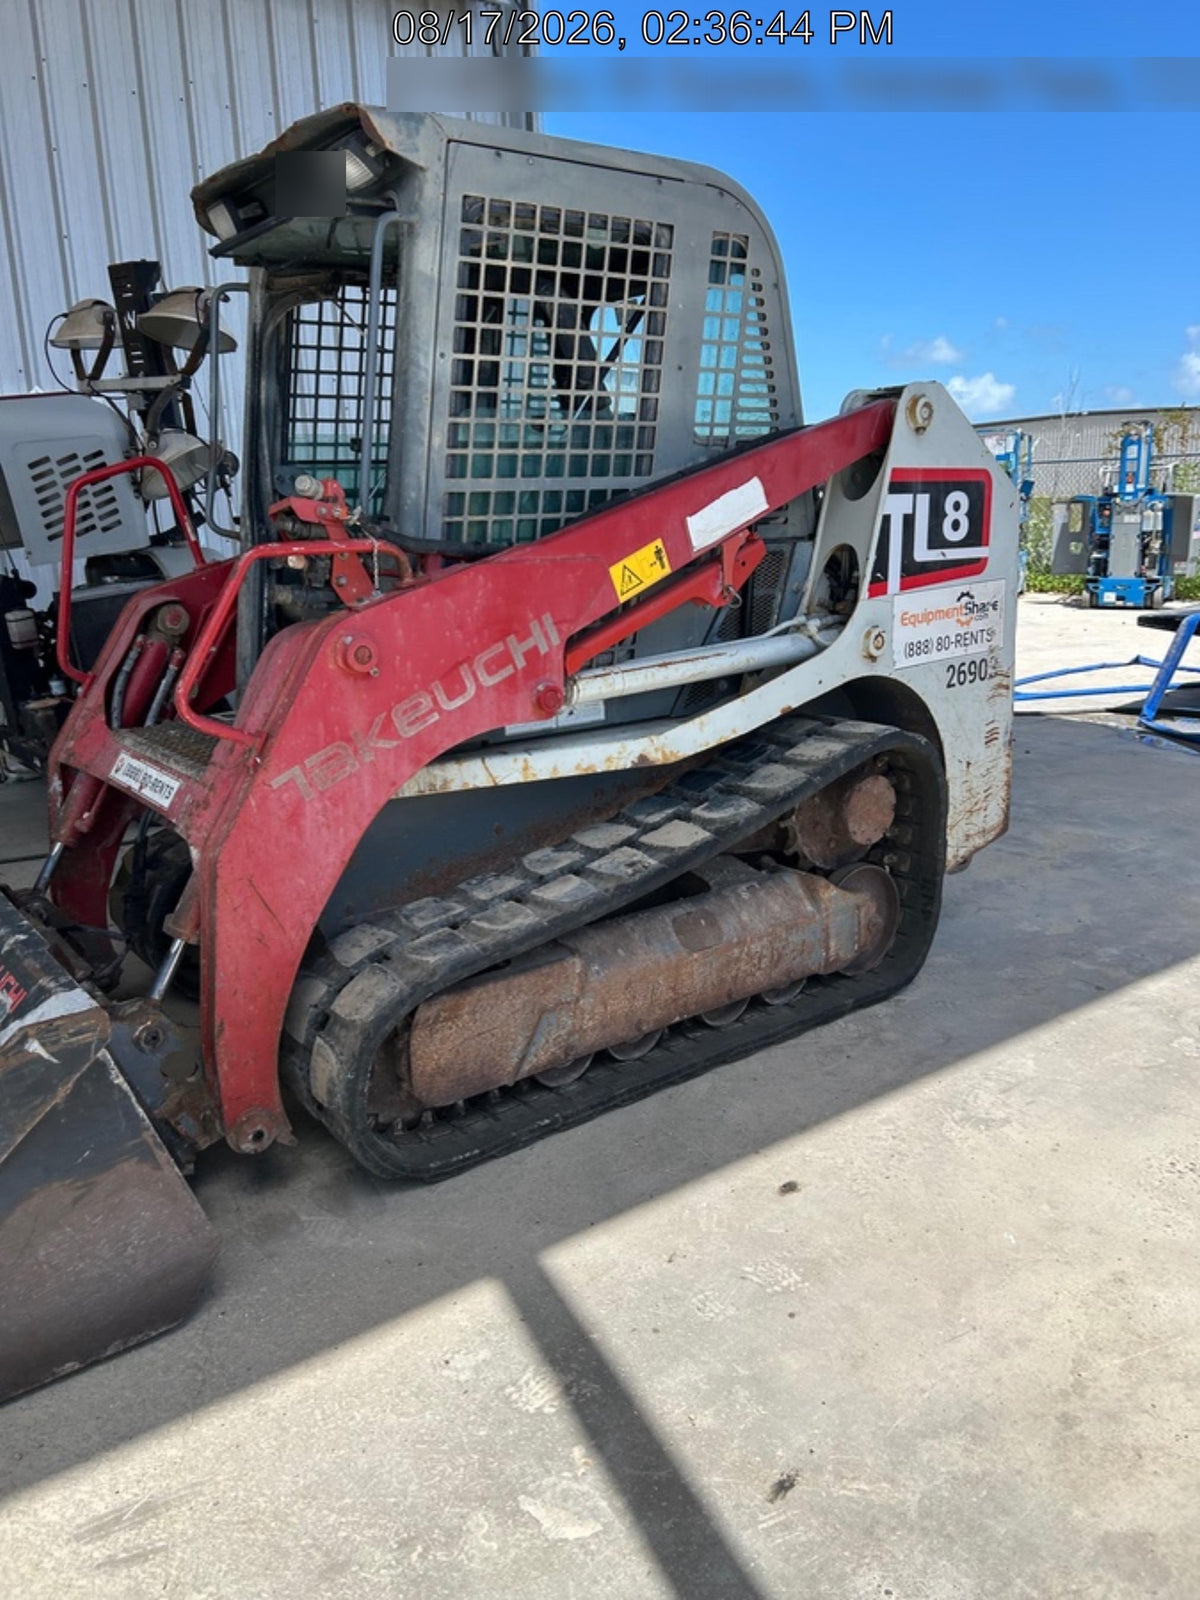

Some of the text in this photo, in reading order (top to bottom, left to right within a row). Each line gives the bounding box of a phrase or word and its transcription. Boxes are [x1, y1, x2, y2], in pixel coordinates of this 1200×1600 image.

[882, 490, 989, 594] TL8
[904, 628, 994, 660] (888) 80-RENTS
